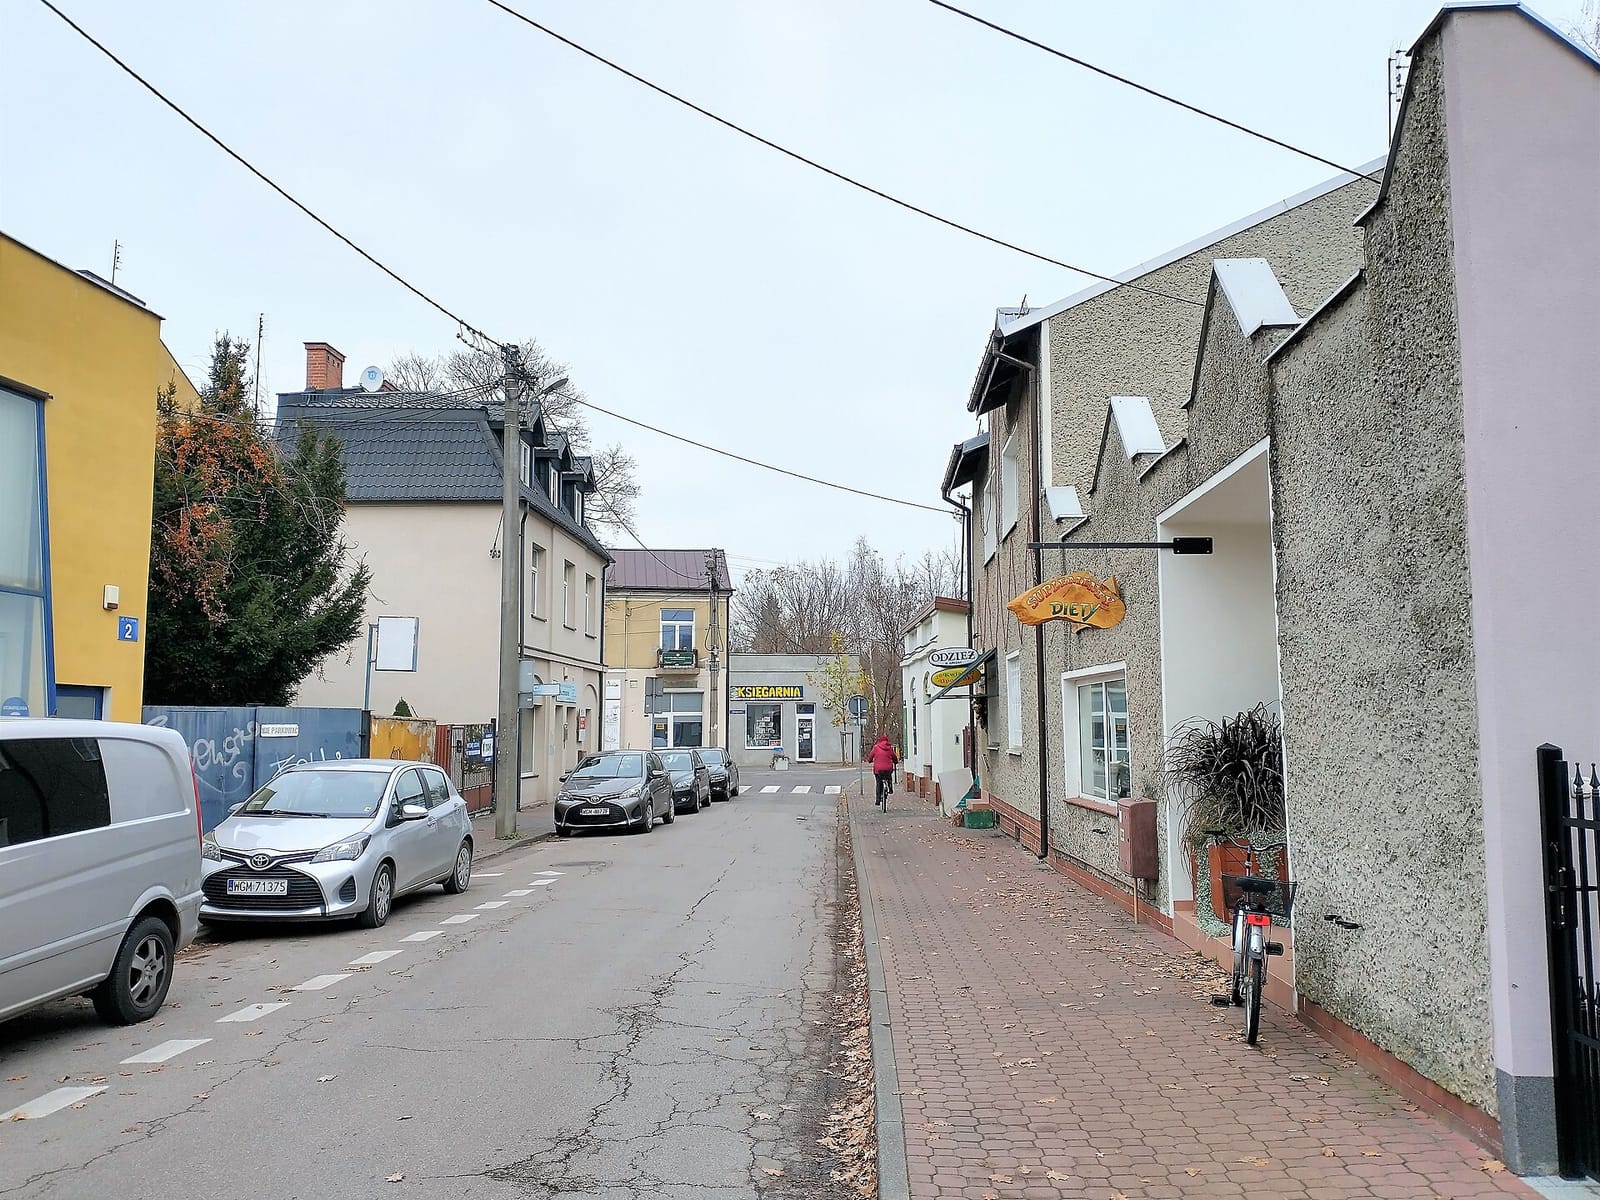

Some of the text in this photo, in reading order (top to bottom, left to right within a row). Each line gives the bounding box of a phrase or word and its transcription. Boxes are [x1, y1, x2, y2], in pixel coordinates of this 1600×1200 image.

[1027, 576, 1115, 609] SUPLEMENTY
[1049, 601, 1102, 622] DIETY
[124, 623, 132, 639] 2
[931, 650, 976, 662] ODZIEŻ
[234, 881, 252, 892] WGM
